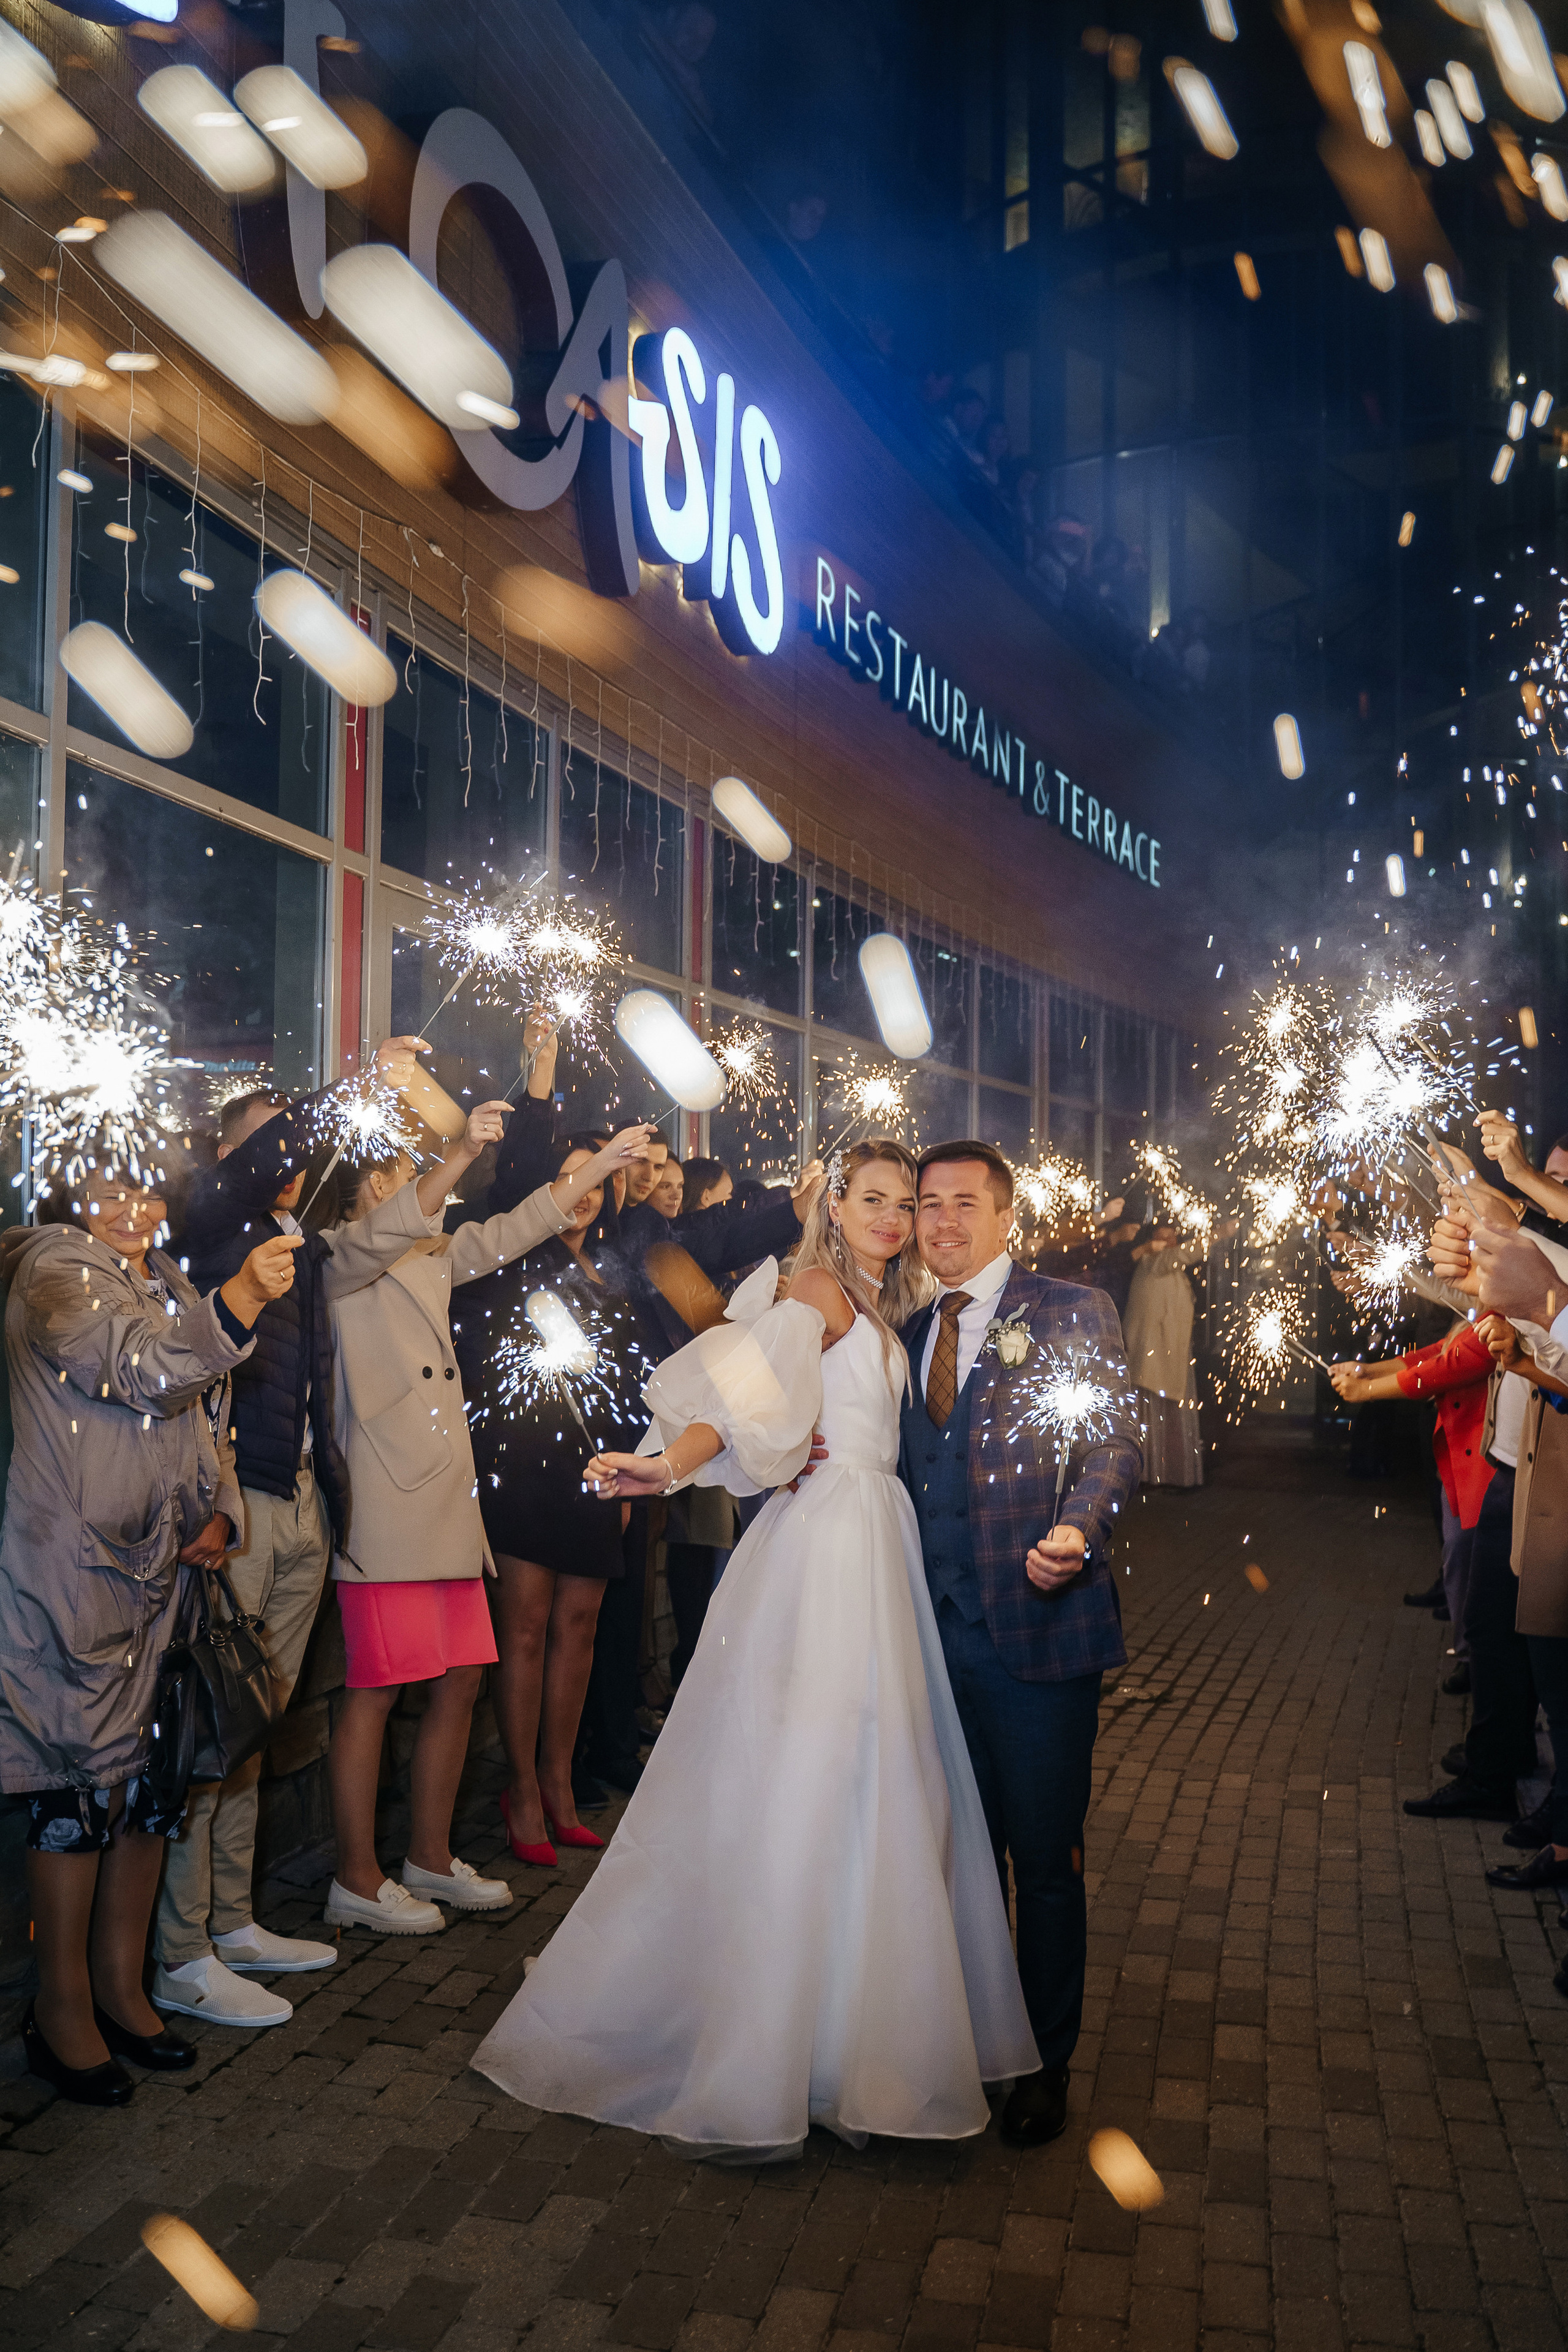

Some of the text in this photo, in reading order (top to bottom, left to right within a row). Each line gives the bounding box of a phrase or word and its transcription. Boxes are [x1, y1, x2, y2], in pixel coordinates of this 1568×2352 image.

[816, 557, 1161, 888] RESTAURANT & TERRACE
